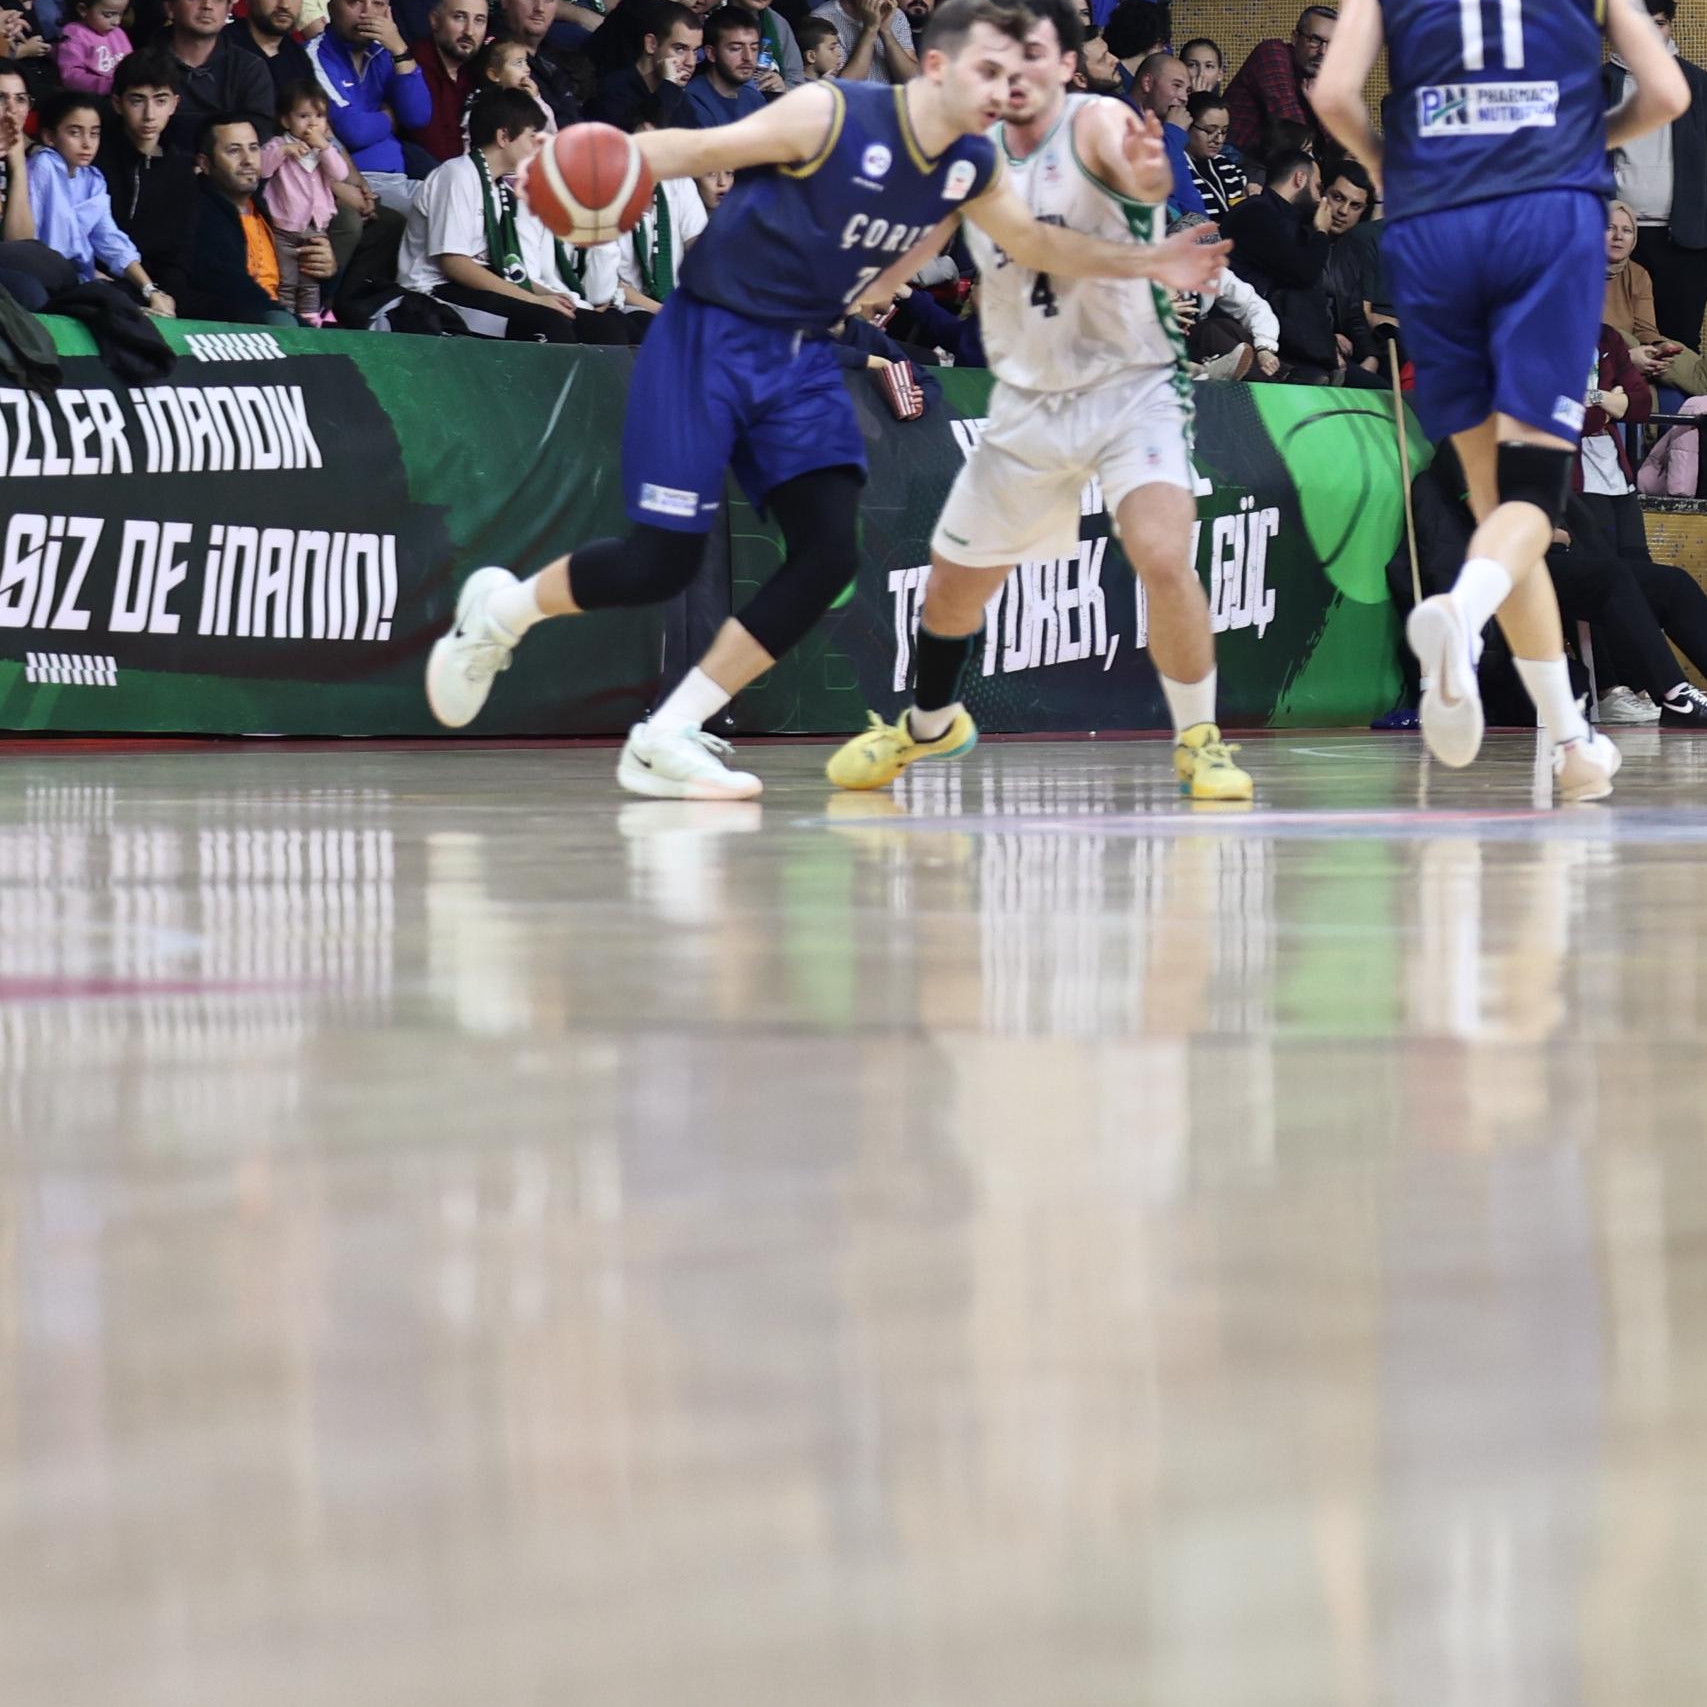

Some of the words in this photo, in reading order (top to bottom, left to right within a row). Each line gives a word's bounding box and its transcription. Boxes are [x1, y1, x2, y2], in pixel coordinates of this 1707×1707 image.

[0, 386, 134, 477] ZLER
[0, 512, 104, 632] SİZ
[108, 519, 194, 634] DE
[1210, 496, 1281, 640] GÜÇ
